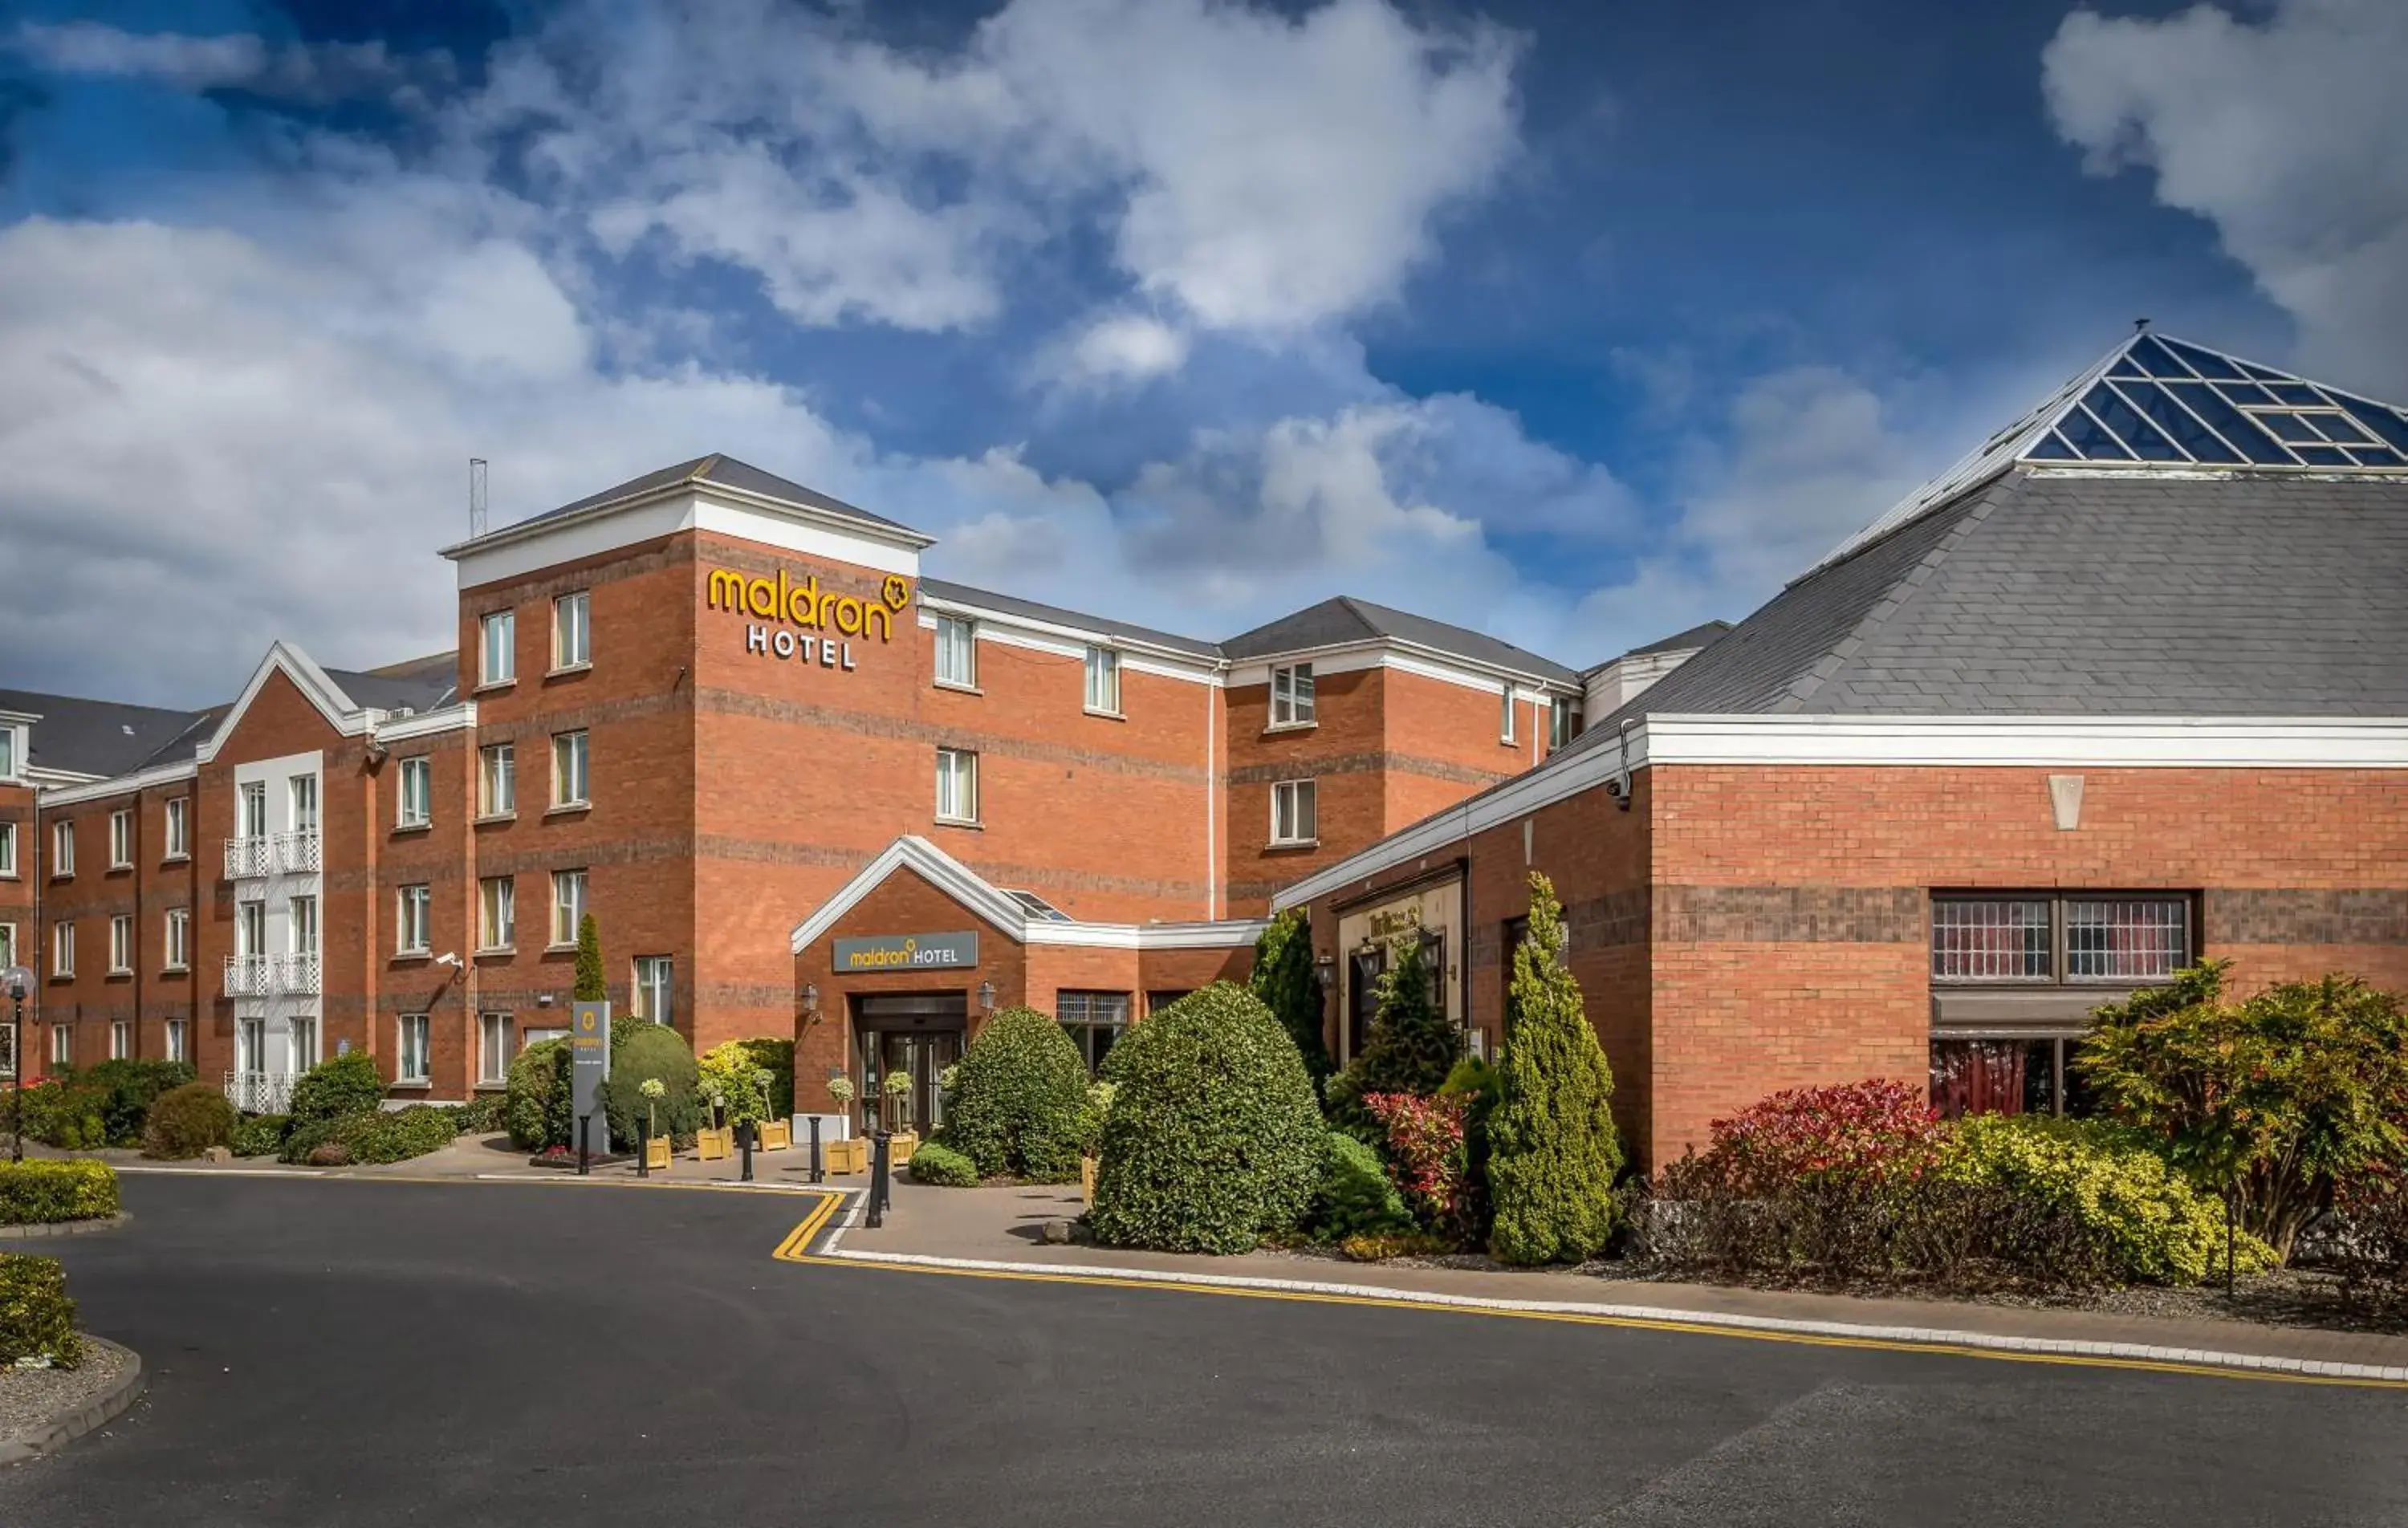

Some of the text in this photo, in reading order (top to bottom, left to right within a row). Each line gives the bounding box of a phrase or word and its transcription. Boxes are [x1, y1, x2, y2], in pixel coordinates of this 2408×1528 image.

[708, 568, 890, 642] maldron
[747, 624, 856, 671] HOTEL
[850, 947, 958, 967] maldron HOTEL
